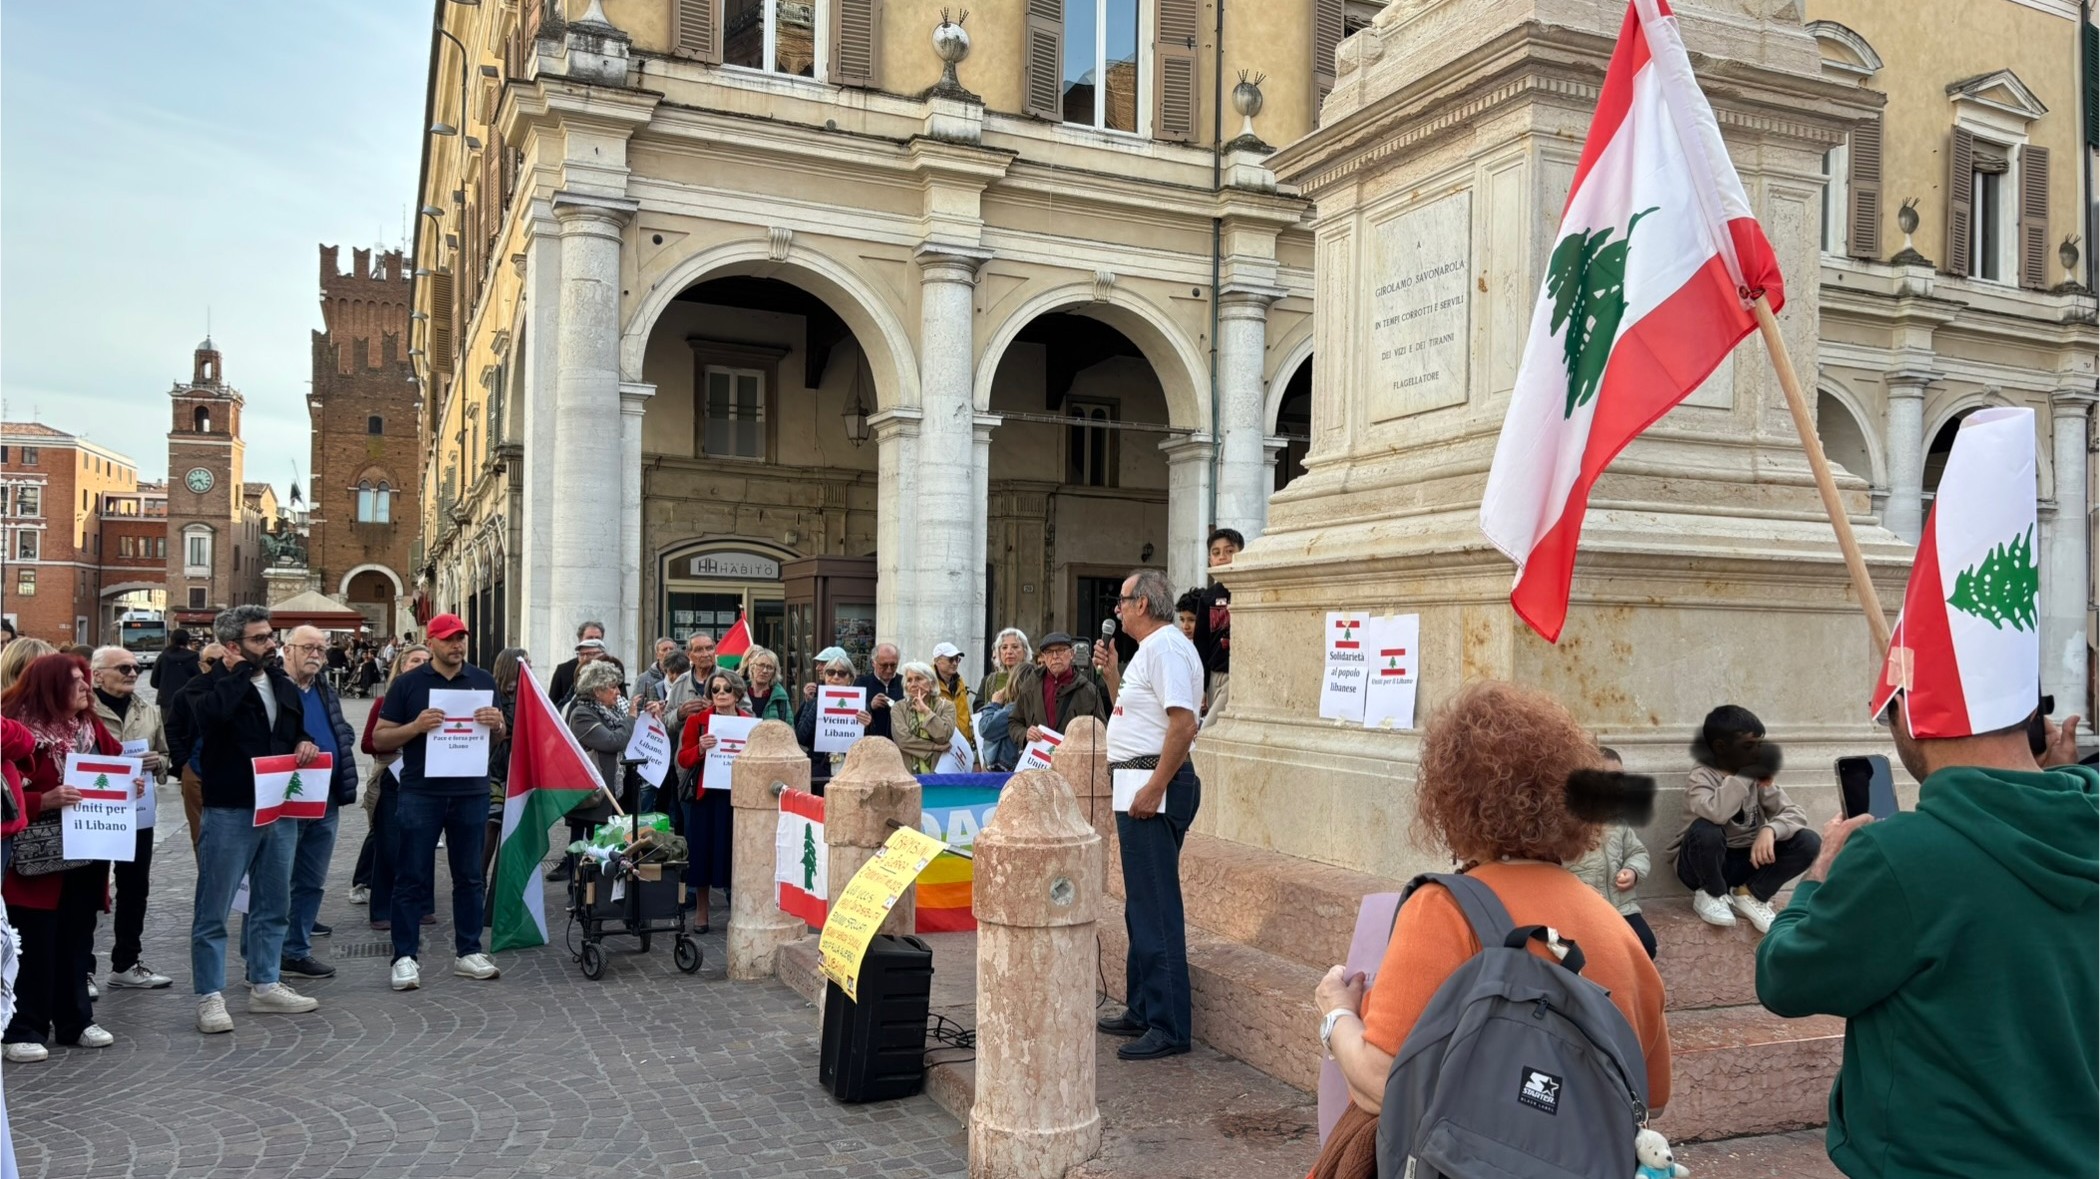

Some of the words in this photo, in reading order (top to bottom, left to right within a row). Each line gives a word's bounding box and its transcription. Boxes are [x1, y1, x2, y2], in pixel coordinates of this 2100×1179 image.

[1416, 241, 1421, 249] A
[1375, 277, 1412, 298] GIROLAMO
[1415, 259, 1465, 284] SAVONAROLA
[1375, 321, 1381, 330] IN
[1383, 315, 1400, 329] TEMPI
[1401, 305, 1433, 322] CORROTTI
[1434, 302, 1438, 312] E
[1440, 295, 1464, 311] SERVILI
[1381, 351, 1391, 361] DEI
[1394, 346, 1406, 357] VIZI
[1415, 340, 1426, 351] DEI
[1429, 333, 1455, 347] TIRANNI
[1393, 371, 1439, 390] FLAGELLATORE
[720, 566, 772, 575] HABITO
[1329, 651, 1364, 662] Solidarietà
[1331, 667, 1338, 676] al
[1338, 667, 1360, 679] popolo
[1330, 682, 1356, 693] libanese
[1383, 678, 1391, 686] per
[823, 716, 849, 725] Vicini
[646, 731, 664, 744] Forza
[824, 729, 856, 737] Libano
[646, 753, 662, 766] siete
[1027, 756, 1048, 769] Uniti
[73, 802, 104, 813] Uniti
[106, 805, 127, 816] per
[74, 819, 82, 830] il
[86, 820, 127, 831] Libano
[1522, 1087, 1555, 1104] STARTER
[1520, 1097, 1537, 1105] BLACK
[1538, 1103, 1554, 1112] LABEL
